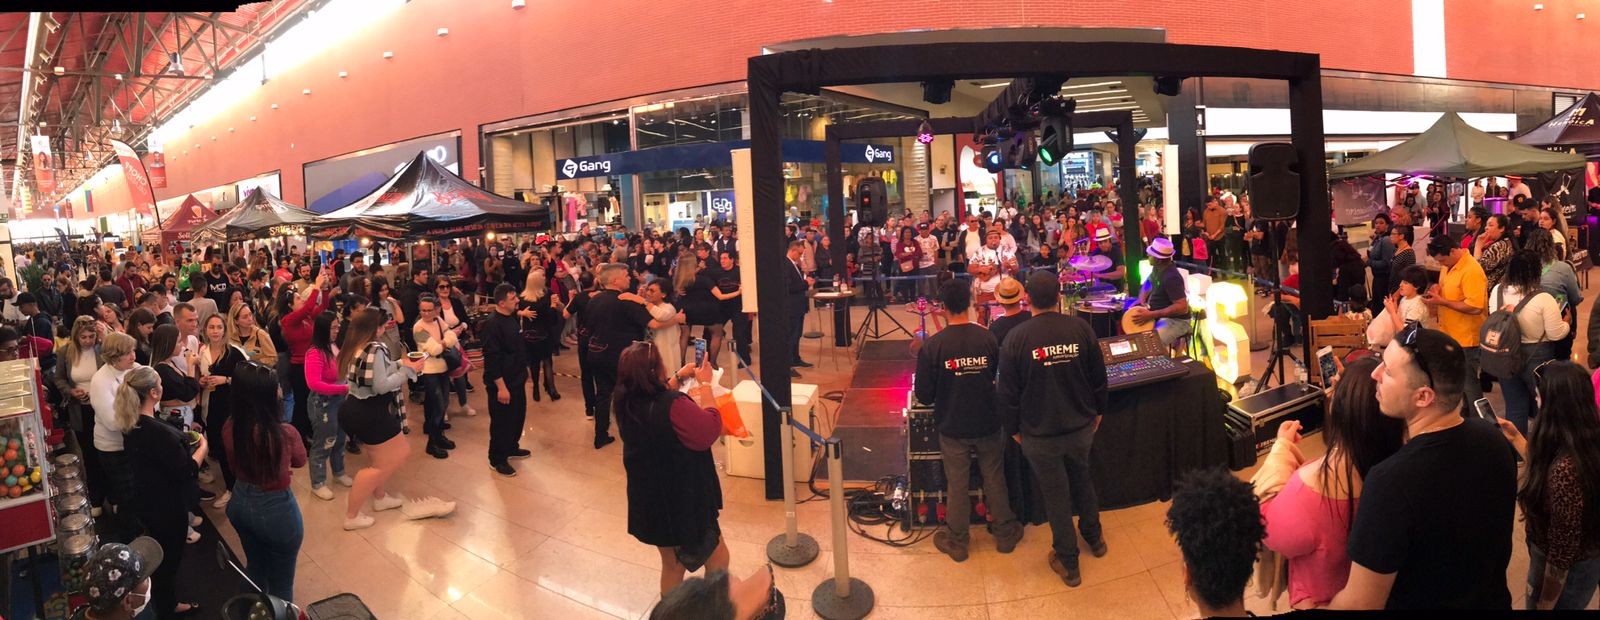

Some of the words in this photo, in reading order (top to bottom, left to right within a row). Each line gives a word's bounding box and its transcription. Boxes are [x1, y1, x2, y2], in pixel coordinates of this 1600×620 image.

[874, 148, 892, 162] Gang
[579, 160, 611, 173] Gang
[1032, 343, 1079, 361] EXTREME
[944, 356, 988, 370] EXTREME
